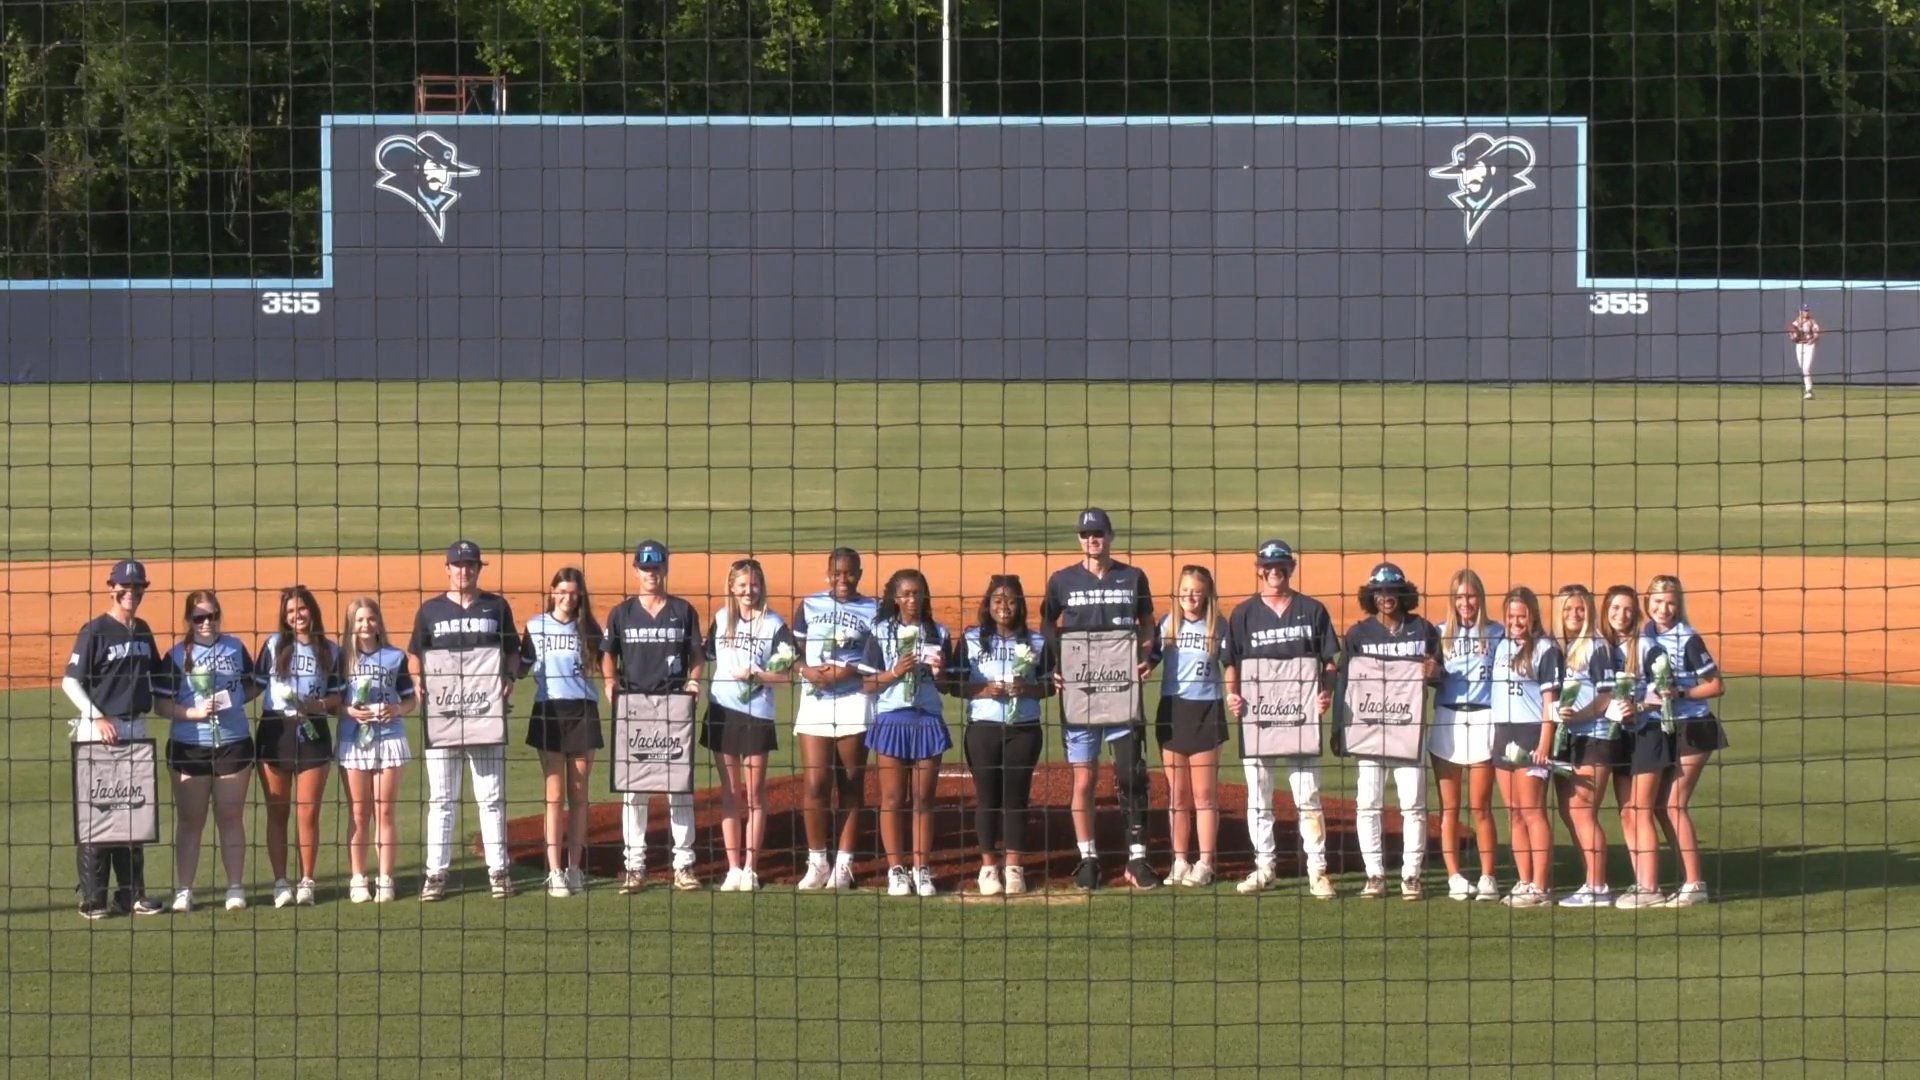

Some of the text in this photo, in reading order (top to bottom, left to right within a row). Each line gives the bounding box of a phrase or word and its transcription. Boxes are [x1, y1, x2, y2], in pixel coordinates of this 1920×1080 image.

[262, 292, 320, 314] 355
[1589, 293, 1649, 314] 355
[434, 617, 498, 638] JACKSON
[1076, 663, 1127, 682] Jackson
[1196, 661, 1211, 677] 25
[436, 686, 487, 706] Jackson
[1508, 682, 1523, 696] 25
[1252, 695, 1302, 716] Jackson
[1359, 693, 1410, 715] Jackson
[629, 729, 681, 748] Jackson
[90, 779, 142, 799] Jackson
